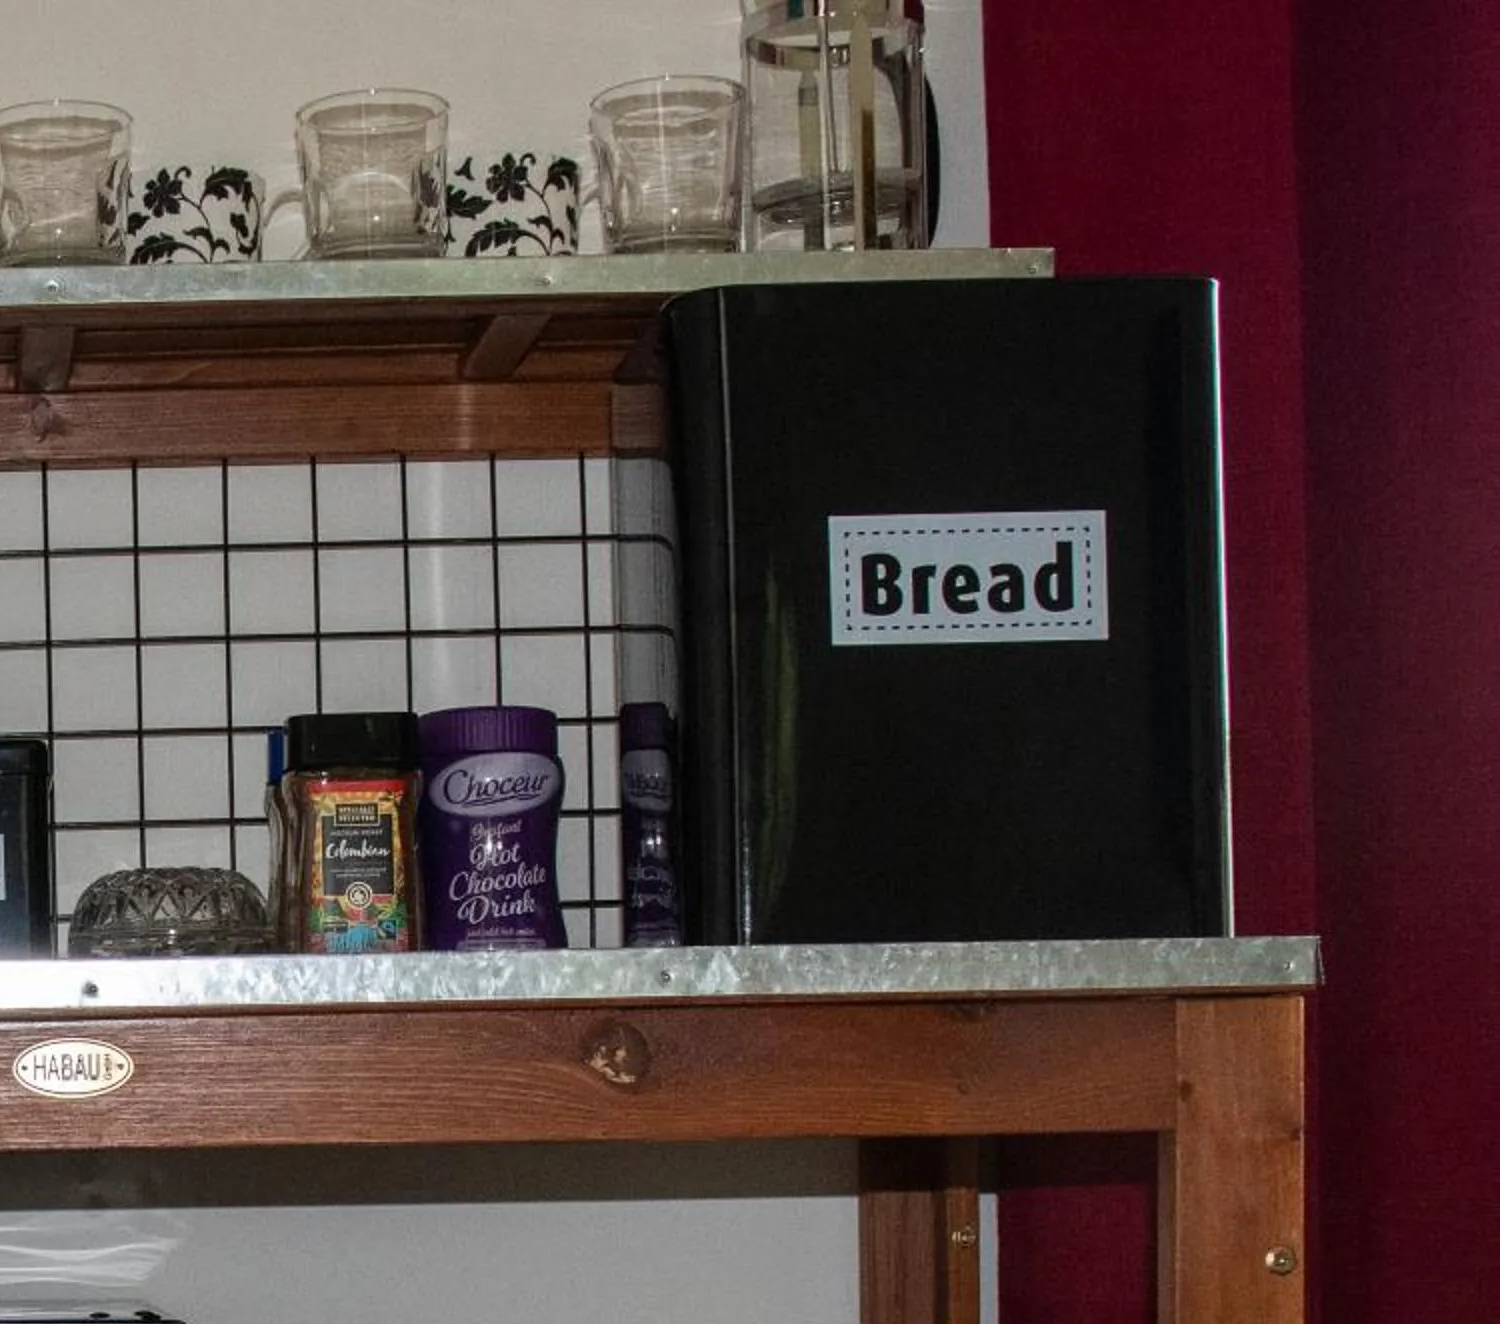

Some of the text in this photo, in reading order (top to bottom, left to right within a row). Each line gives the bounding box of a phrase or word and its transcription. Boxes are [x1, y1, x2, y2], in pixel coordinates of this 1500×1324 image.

[861, 541, 1074, 616] Bread
[443, 769, 549, 804] Choceur
[325, 839, 391, 860] Colombian
[468, 842, 521, 871] Hot
[449, 861, 547, 902] Chocolate
[457, 889, 536, 925] Drink
[33, 1054, 100, 1081] HABAU
